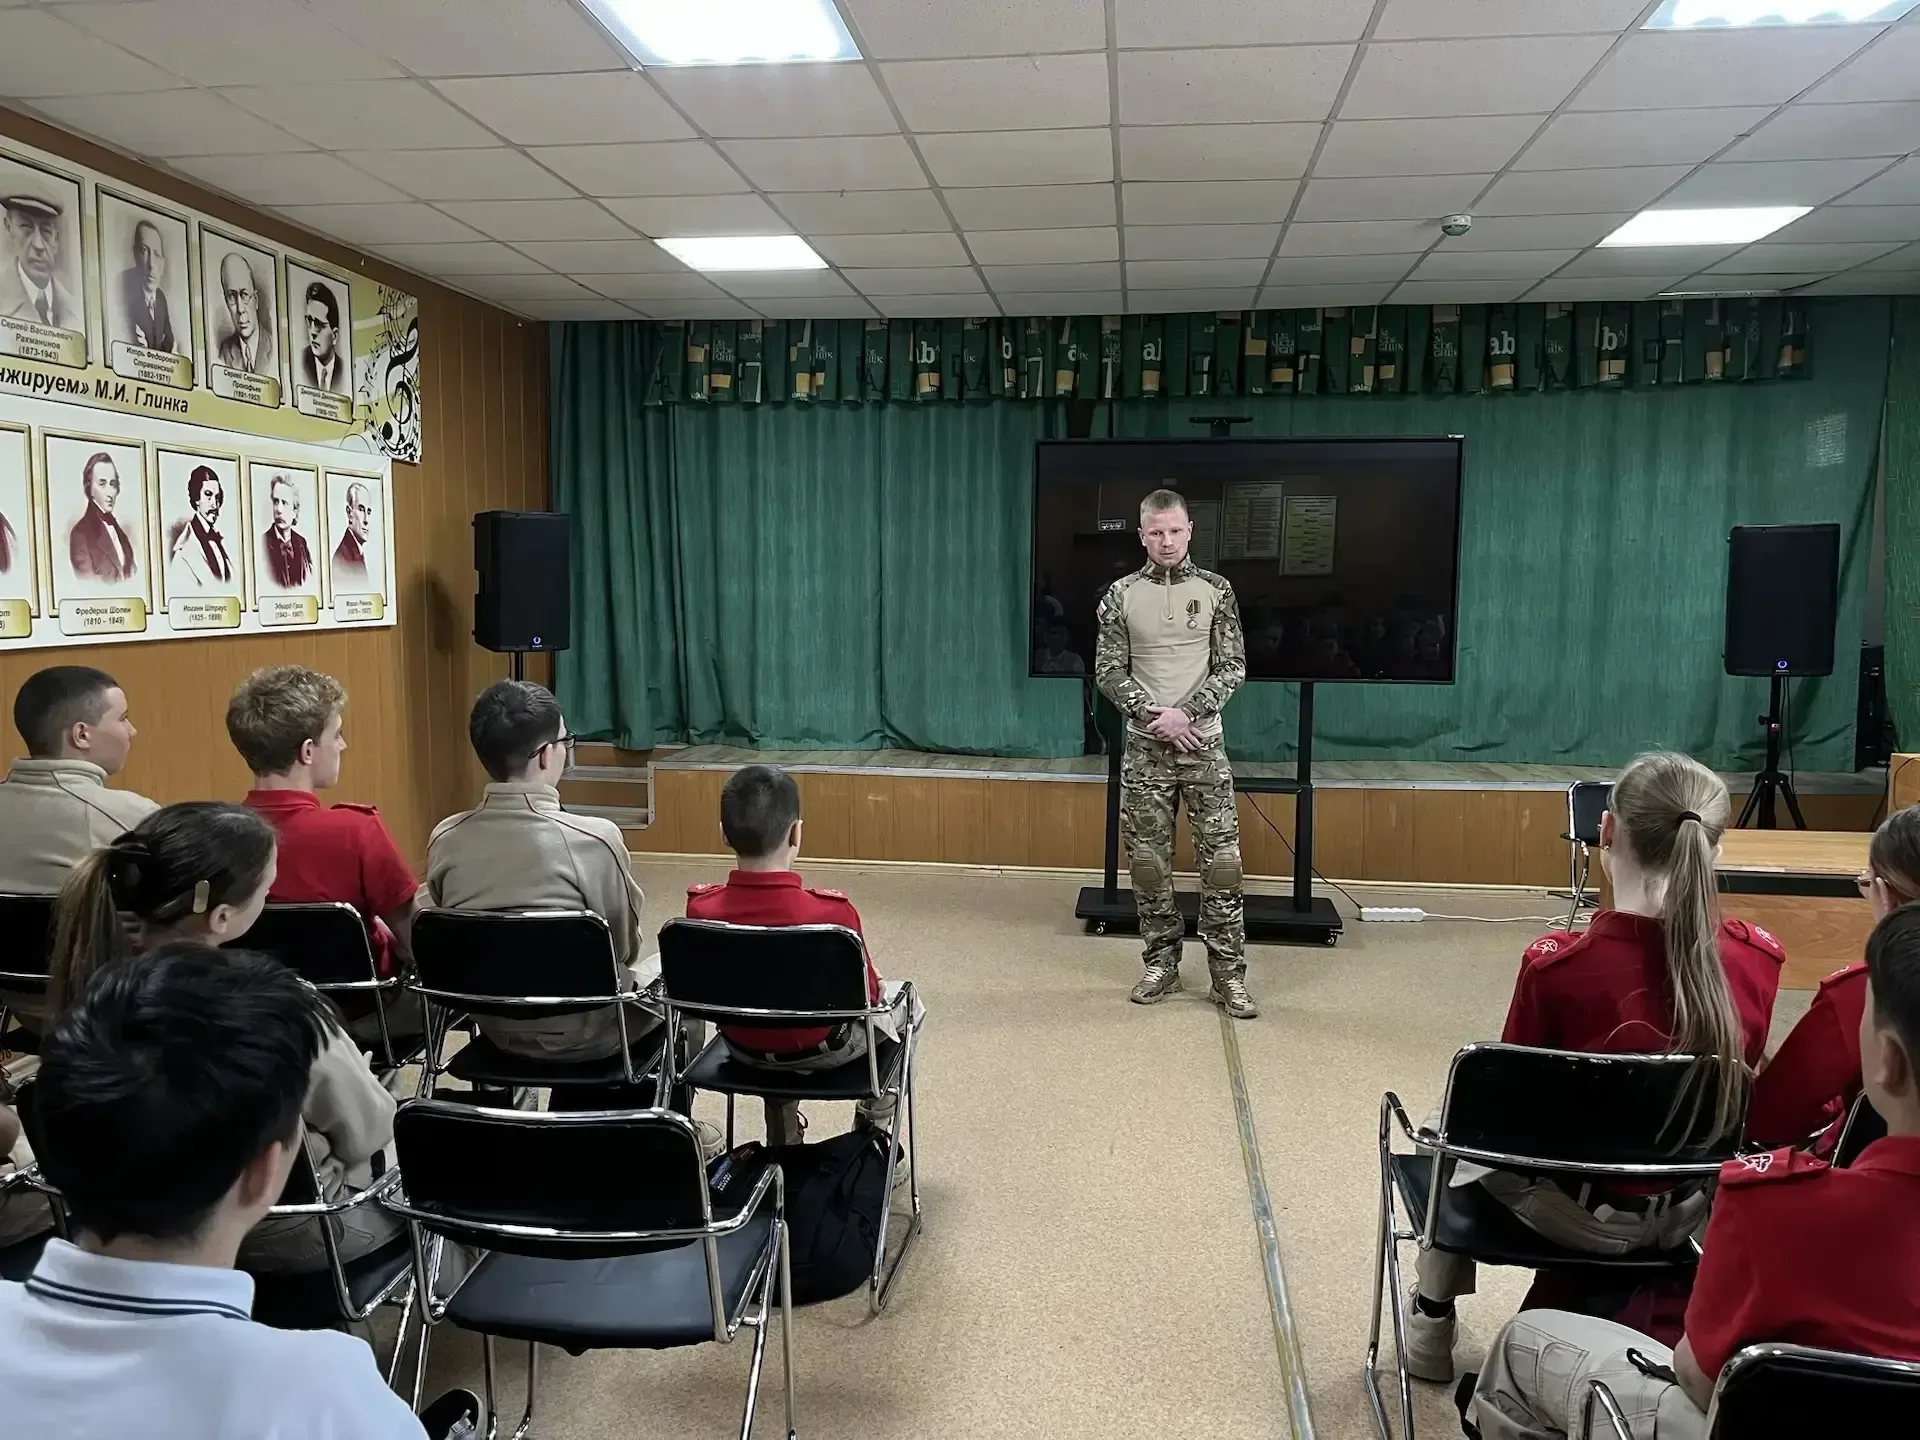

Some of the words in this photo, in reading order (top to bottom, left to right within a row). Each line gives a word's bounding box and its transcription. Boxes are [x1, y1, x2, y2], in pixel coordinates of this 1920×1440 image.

[1, 319, 28, 331] Сергей
[30, 325, 73, 341] Васильевич
[16, 333, 60, 349] Рахманинов
[19, 345, 59, 361] (1873-1943)
[126, 347, 145, 358] Игорь
[147, 351, 180, 364] Федорович
[133, 358, 174, 373] Стравинский
[138, 370, 171, 384] (1882-1971)
[95, 379, 129, 403] М.И.
[135, 387, 188, 413] Глинка
[75, 606, 108, 616] Фредерик
[109, 606, 131, 614] Шопен
[84, 617, 101, 627] (1810
[108, 617, 125, 625] 1849)
